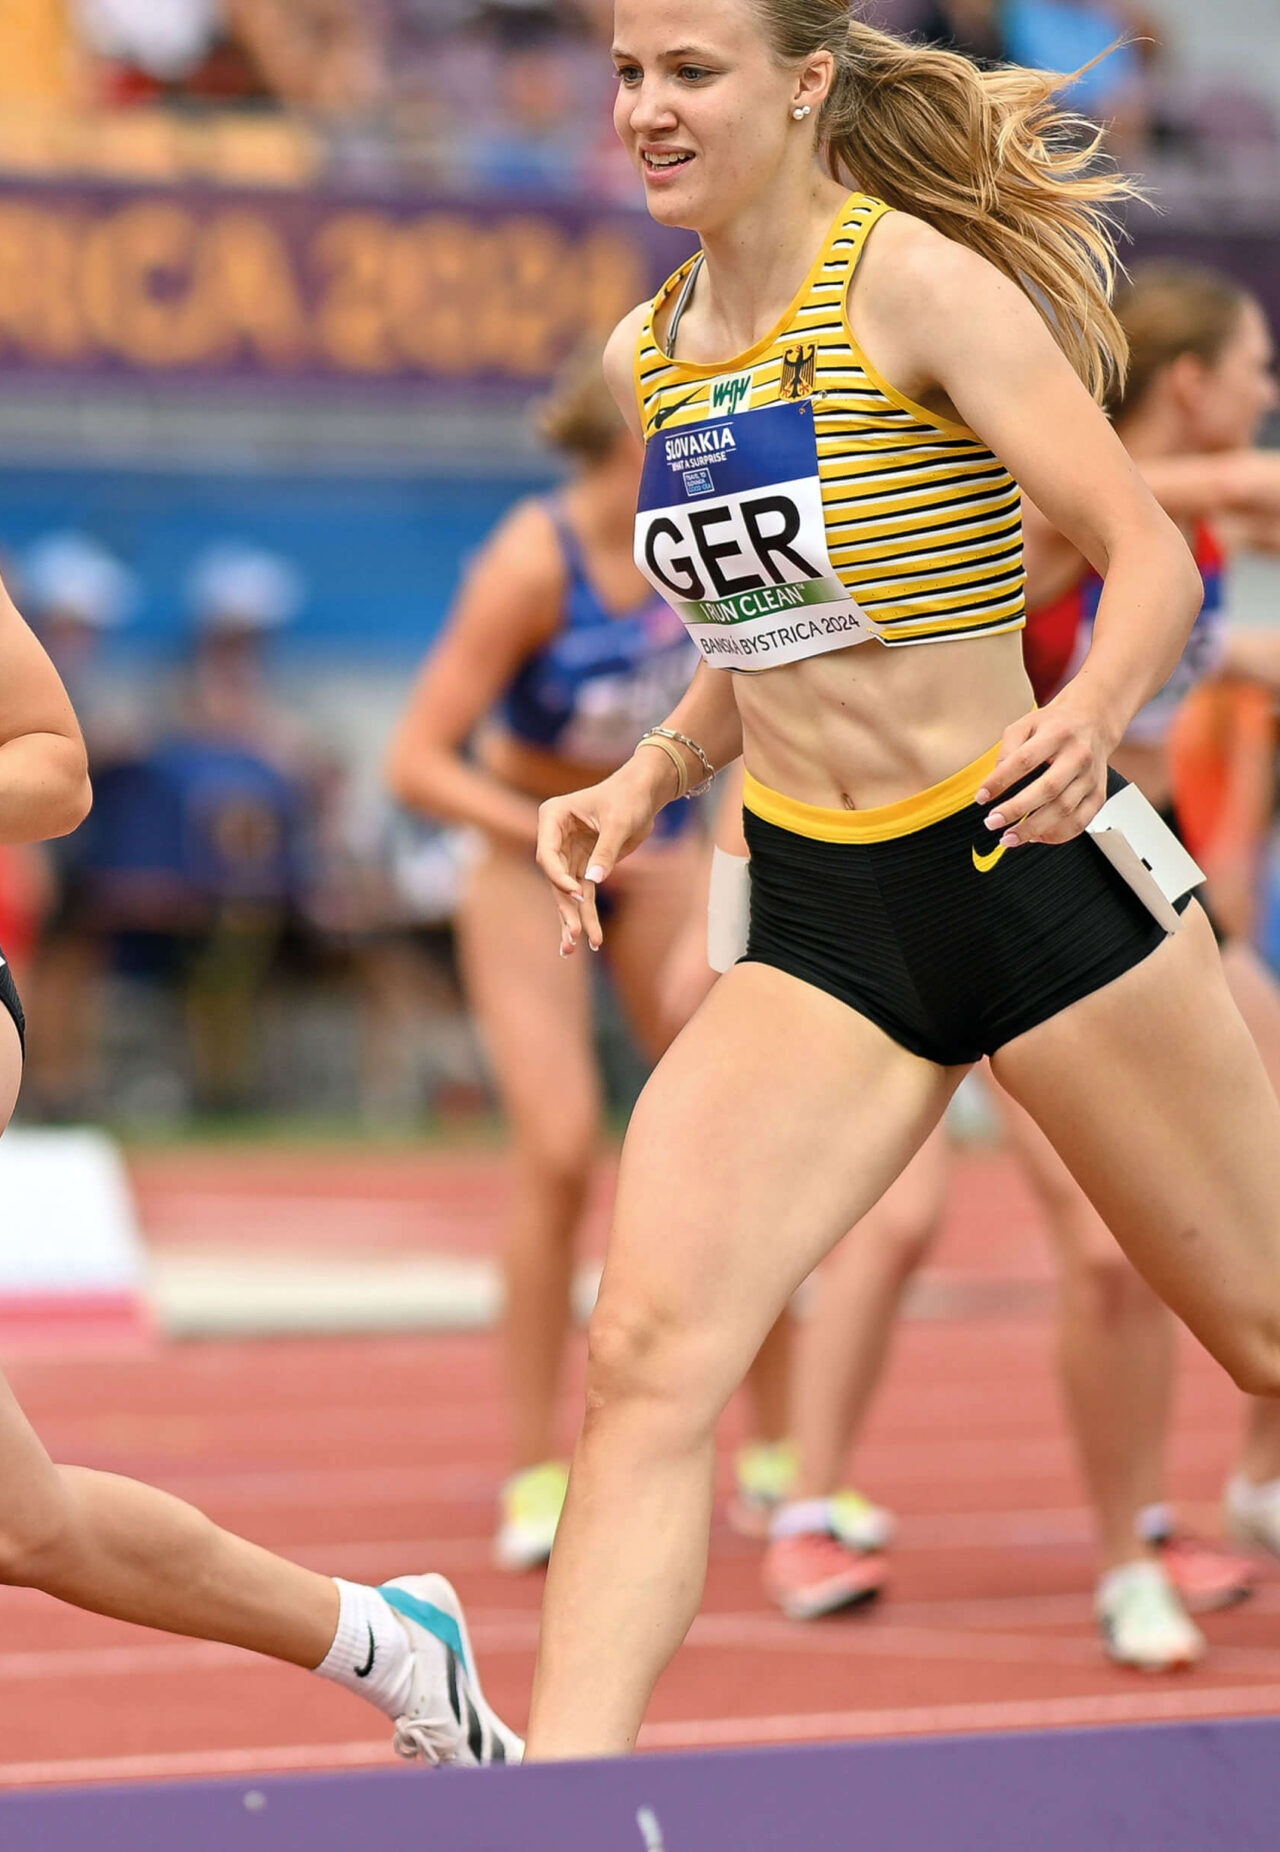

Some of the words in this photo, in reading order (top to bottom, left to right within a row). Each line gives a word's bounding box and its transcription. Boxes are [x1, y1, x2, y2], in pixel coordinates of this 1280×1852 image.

[665, 427, 736, 461] SLOVAKIA
[691, 450, 728, 468] SURPRISE
[645, 495, 823, 601] GER
[699, 603, 709, 621] I
[707, 602, 738, 623] RUN
[700, 634, 744, 656] BANSKÁ
[739, 620, 824, 656] BYSTRICA
[821, 613, 861, 635] 2024
